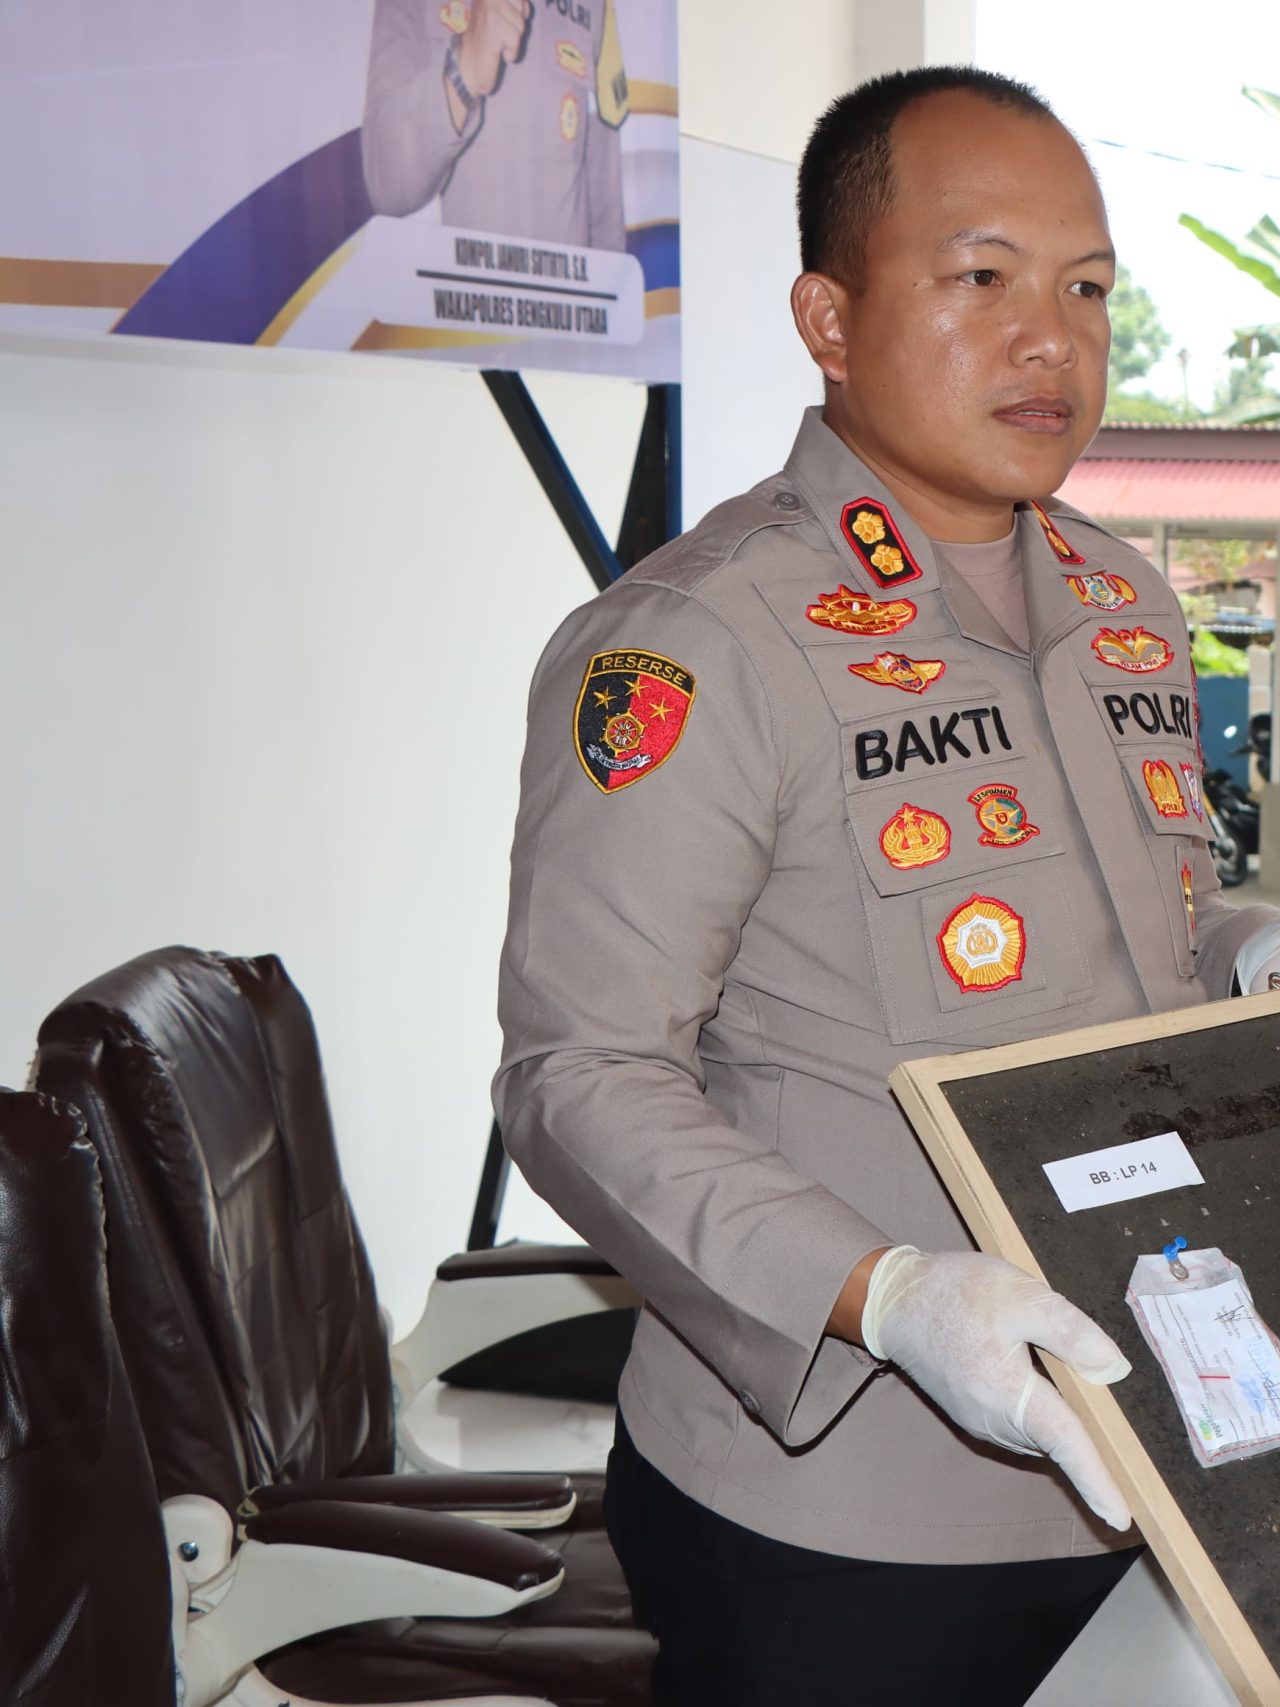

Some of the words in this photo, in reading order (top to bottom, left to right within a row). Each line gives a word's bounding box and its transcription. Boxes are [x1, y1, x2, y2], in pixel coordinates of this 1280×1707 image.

[455, 237, 495, 270] KOMPOL
[433, 289, 515, 326] WAKAPOLRES
[516, 298, 572, 332] BENGKULU
[574, 304, 608, 335] UTARA
[602, 656, 687, 687] RESERSE
[1103, 692, 1193, 740] POLRI
[855, 705, 1013, 781] BAKTI
[1089, 1170, 1111, 1185] BB
[1120, 1165, 1138, 1179] LP
[1141, 1161, 1157, 1175] 14
